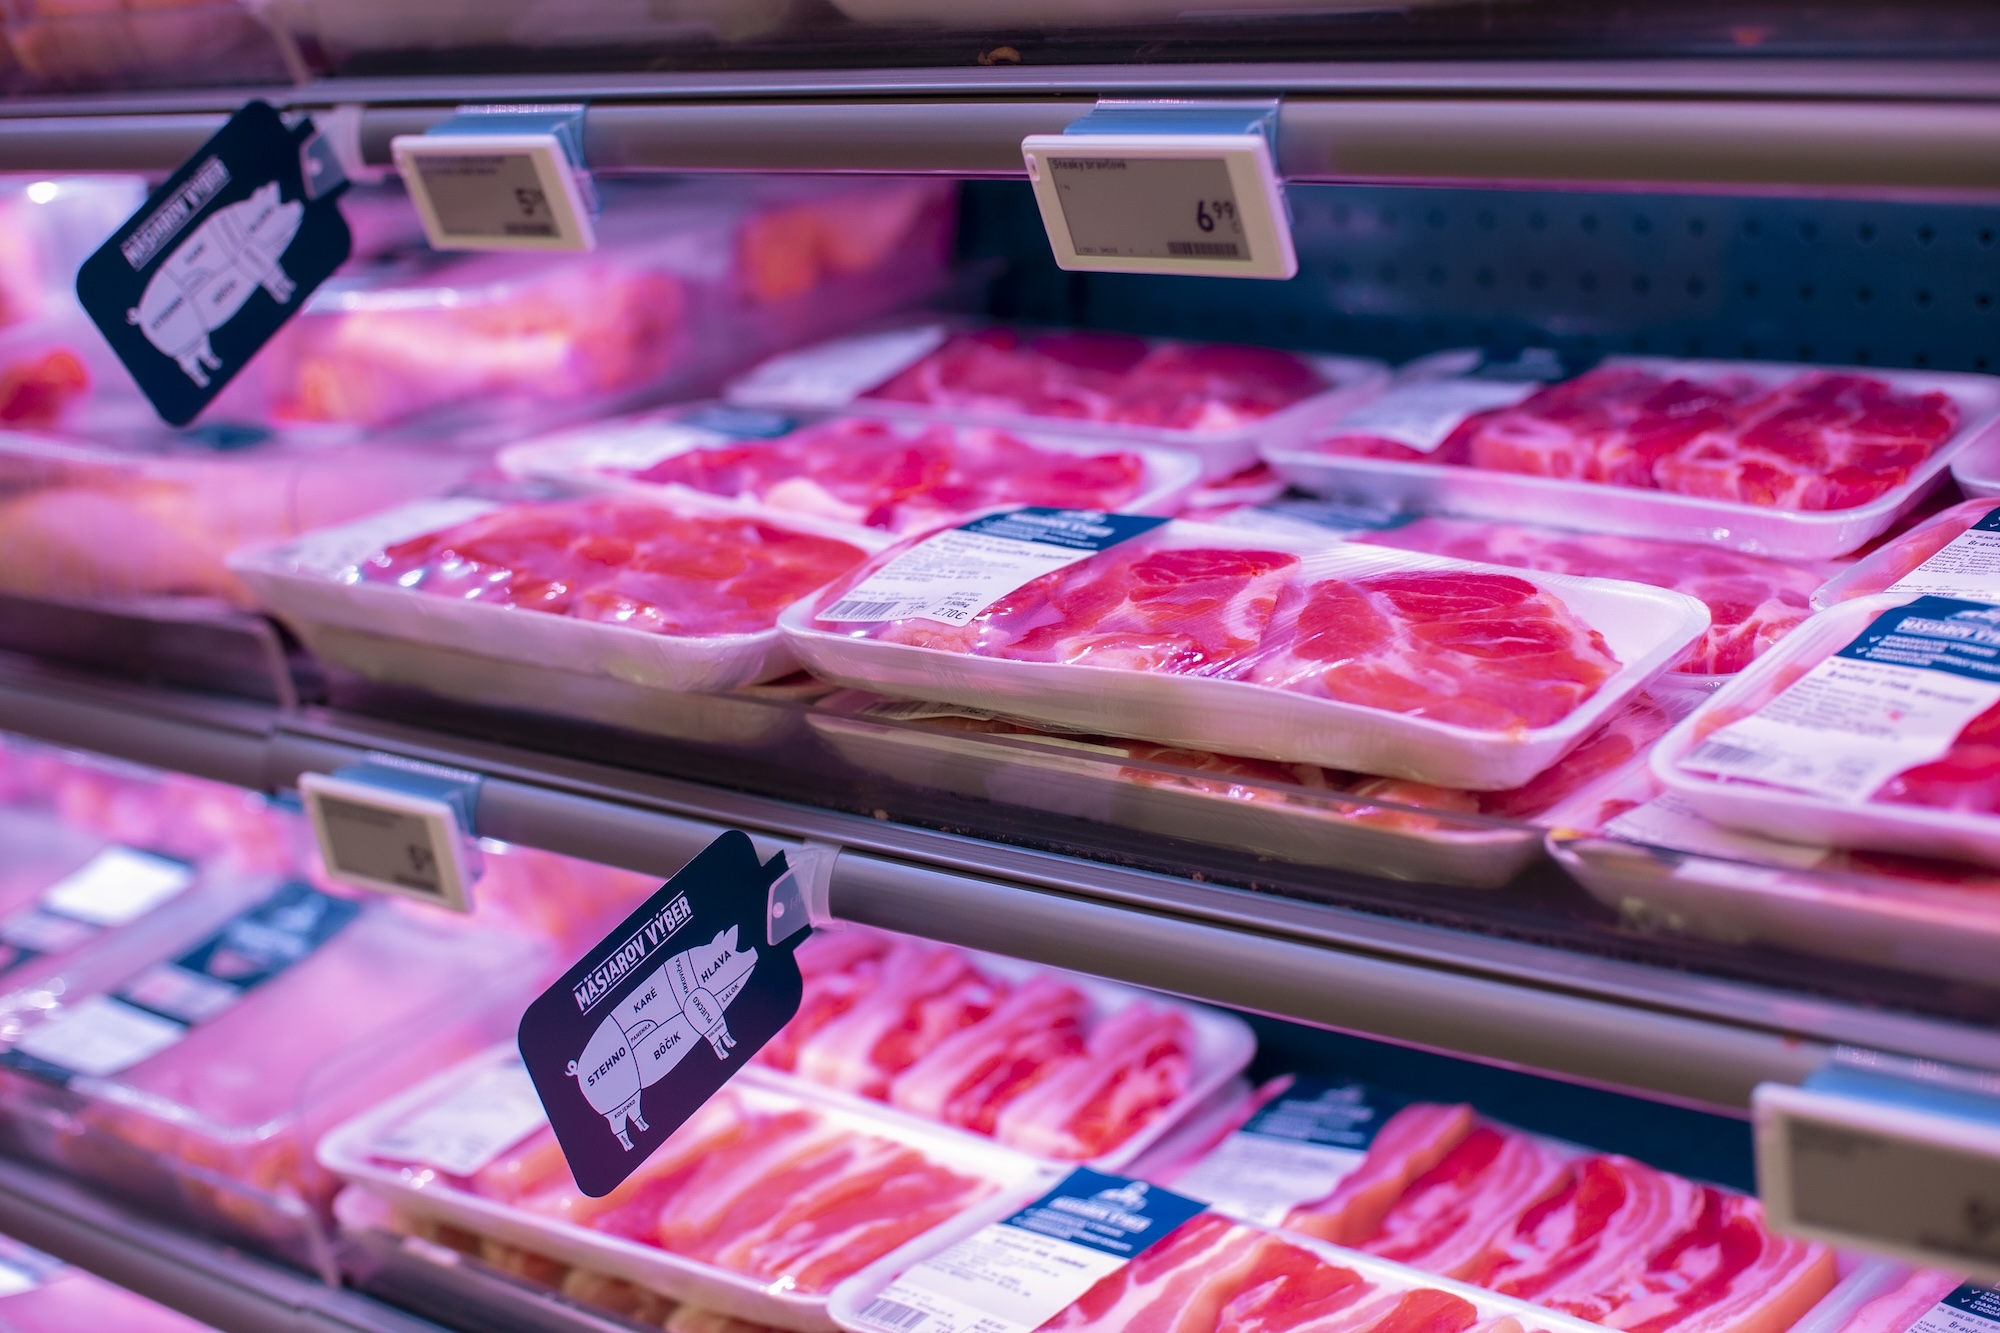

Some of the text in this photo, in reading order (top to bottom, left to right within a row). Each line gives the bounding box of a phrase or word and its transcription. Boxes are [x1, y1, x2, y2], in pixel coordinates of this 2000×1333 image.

[1052, 159, 1084, 172] Steaky
[932, 607, 968, 619] 2.70€
[574, 895, 692, 1012] MÄSIAROV VÝBER
[700, 950, 732, 983] HLAVA
[675, 957, 690, 995] KRKOVIČKA
[633, 986, 658, 1014] KARÉ
[721, 982, 740, 1003] LALOK
[692, 996, 713, 1024] PLIECKO
[630, 1022, 652, 1043] PANENKA
[653, 1031, 682, 1061] BÔČIK
[587, 1046, 626, 1087] STEHNO
